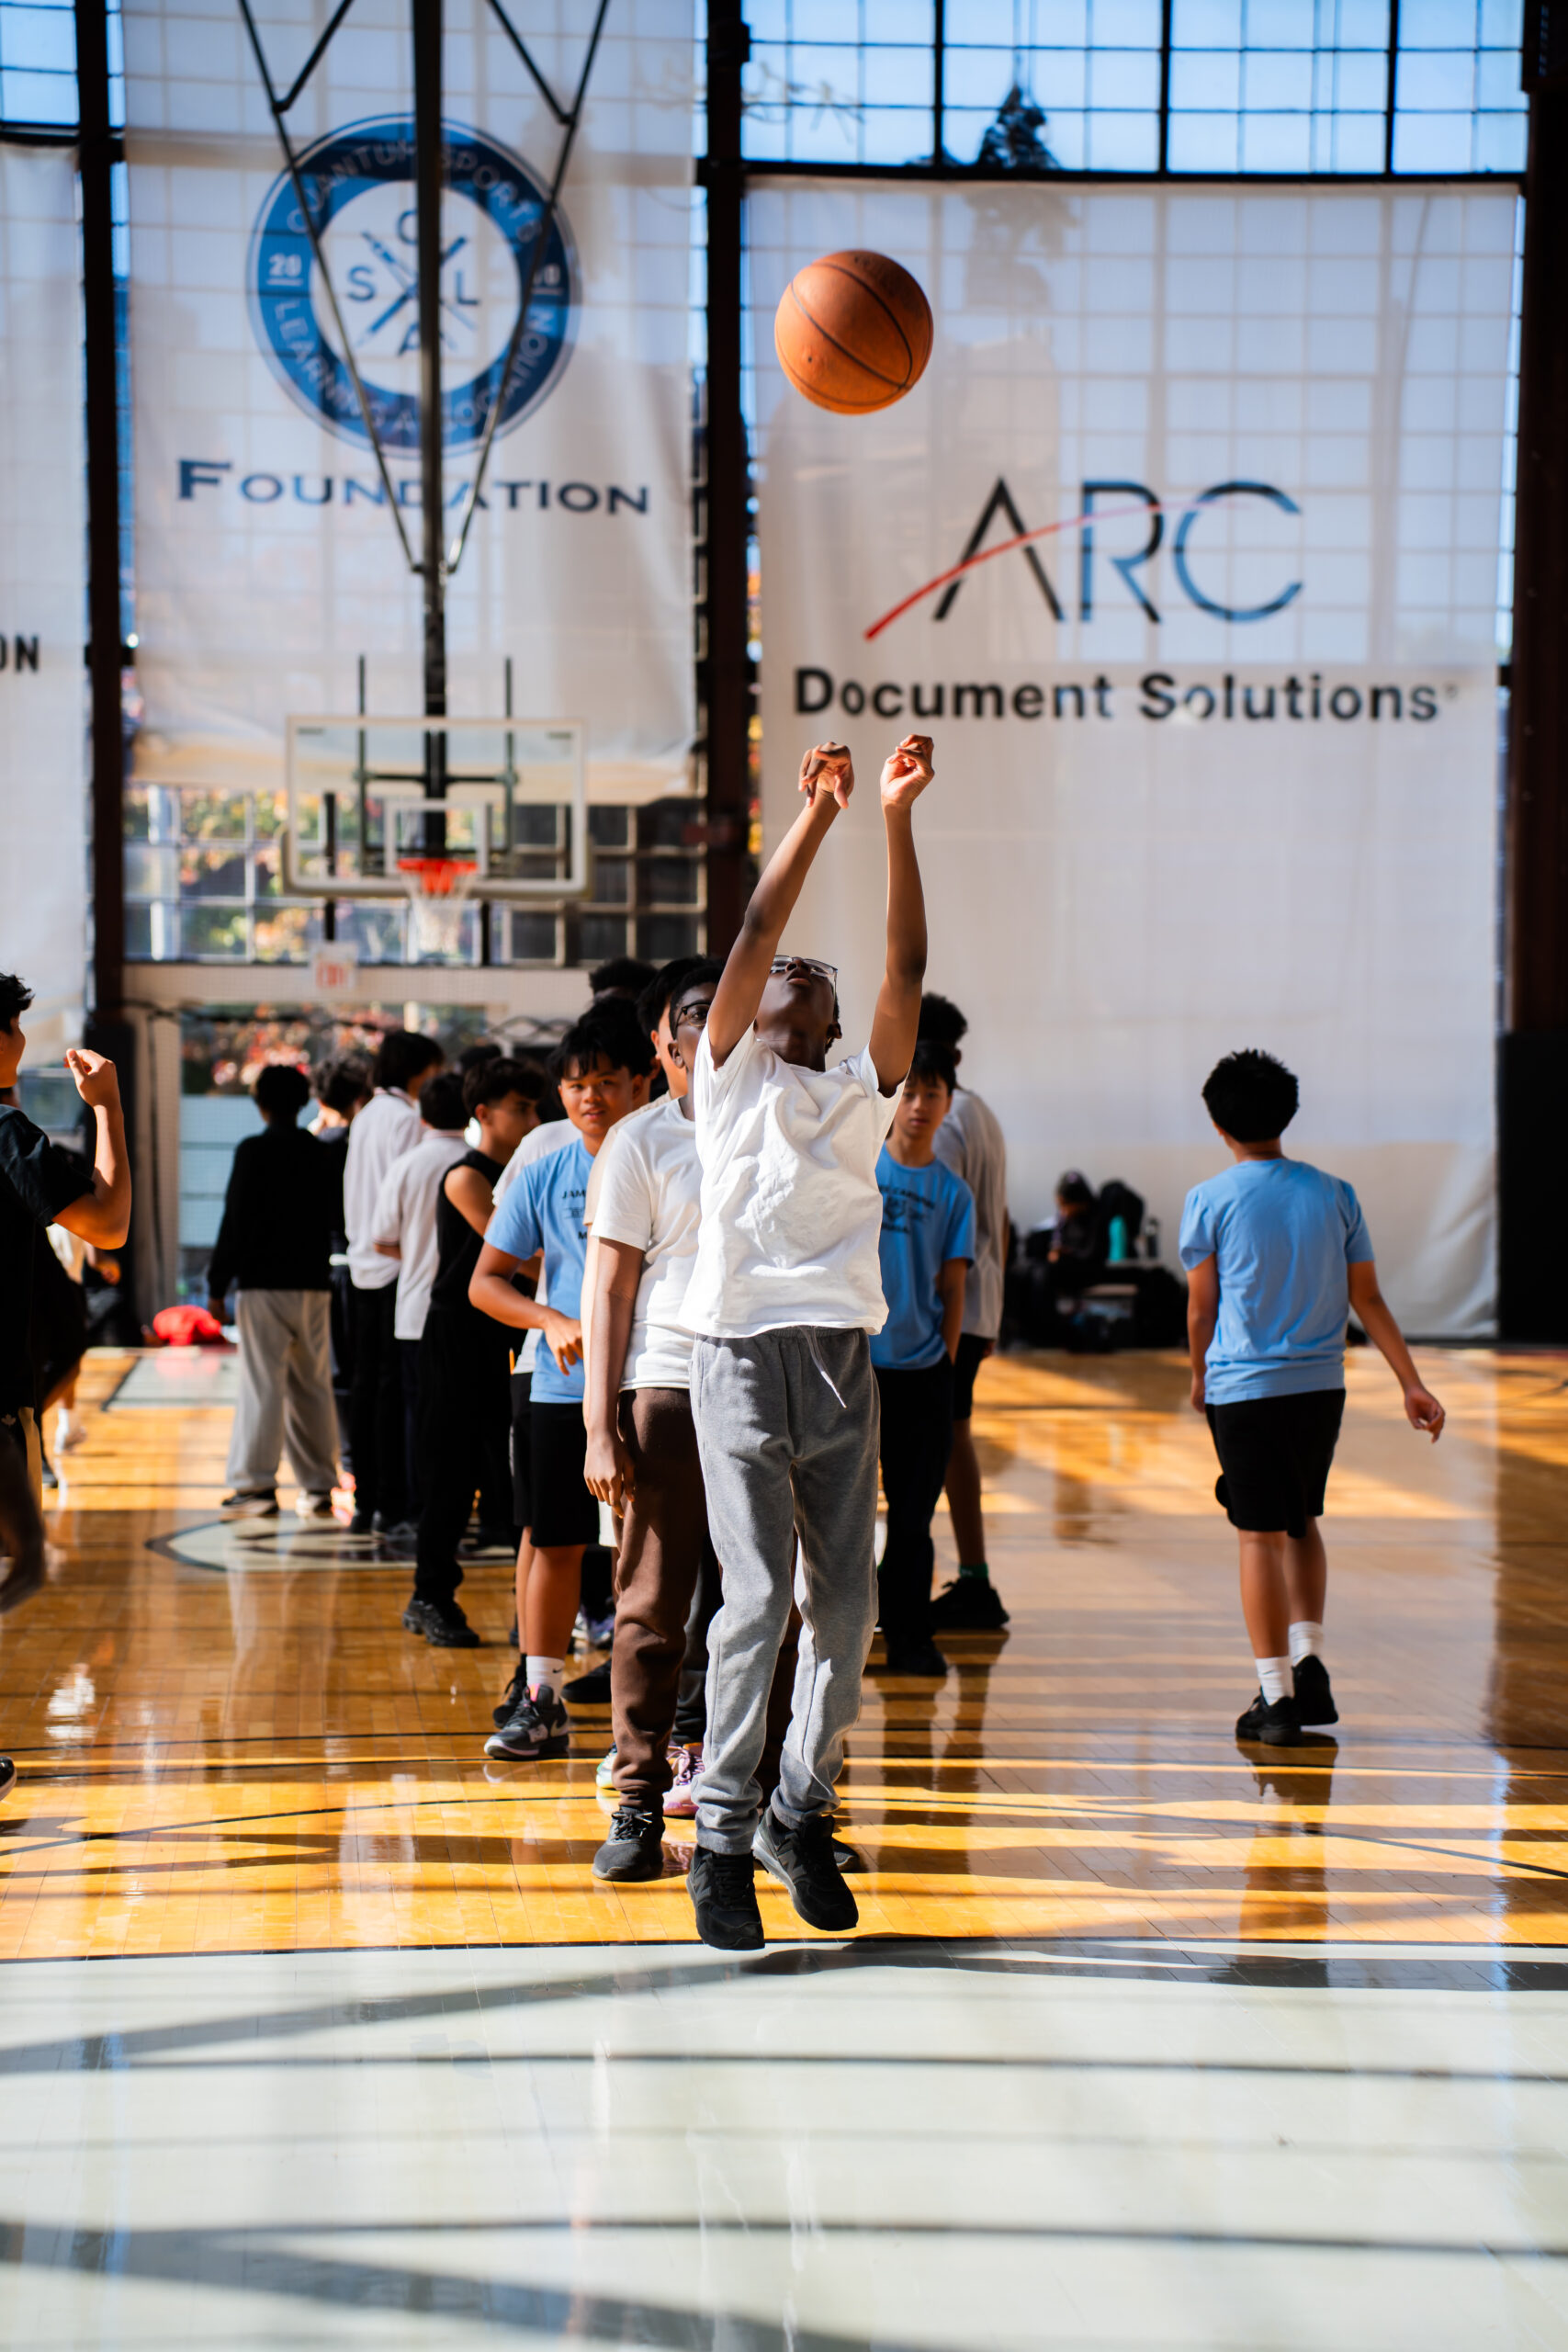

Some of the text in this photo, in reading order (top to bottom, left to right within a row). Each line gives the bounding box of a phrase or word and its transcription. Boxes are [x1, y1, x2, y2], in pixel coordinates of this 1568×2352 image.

[179, 459, 650, 514] FOUNDATION
[931, 475, 1304, 624] ARC
[794, 667, 1113, 719] Document
